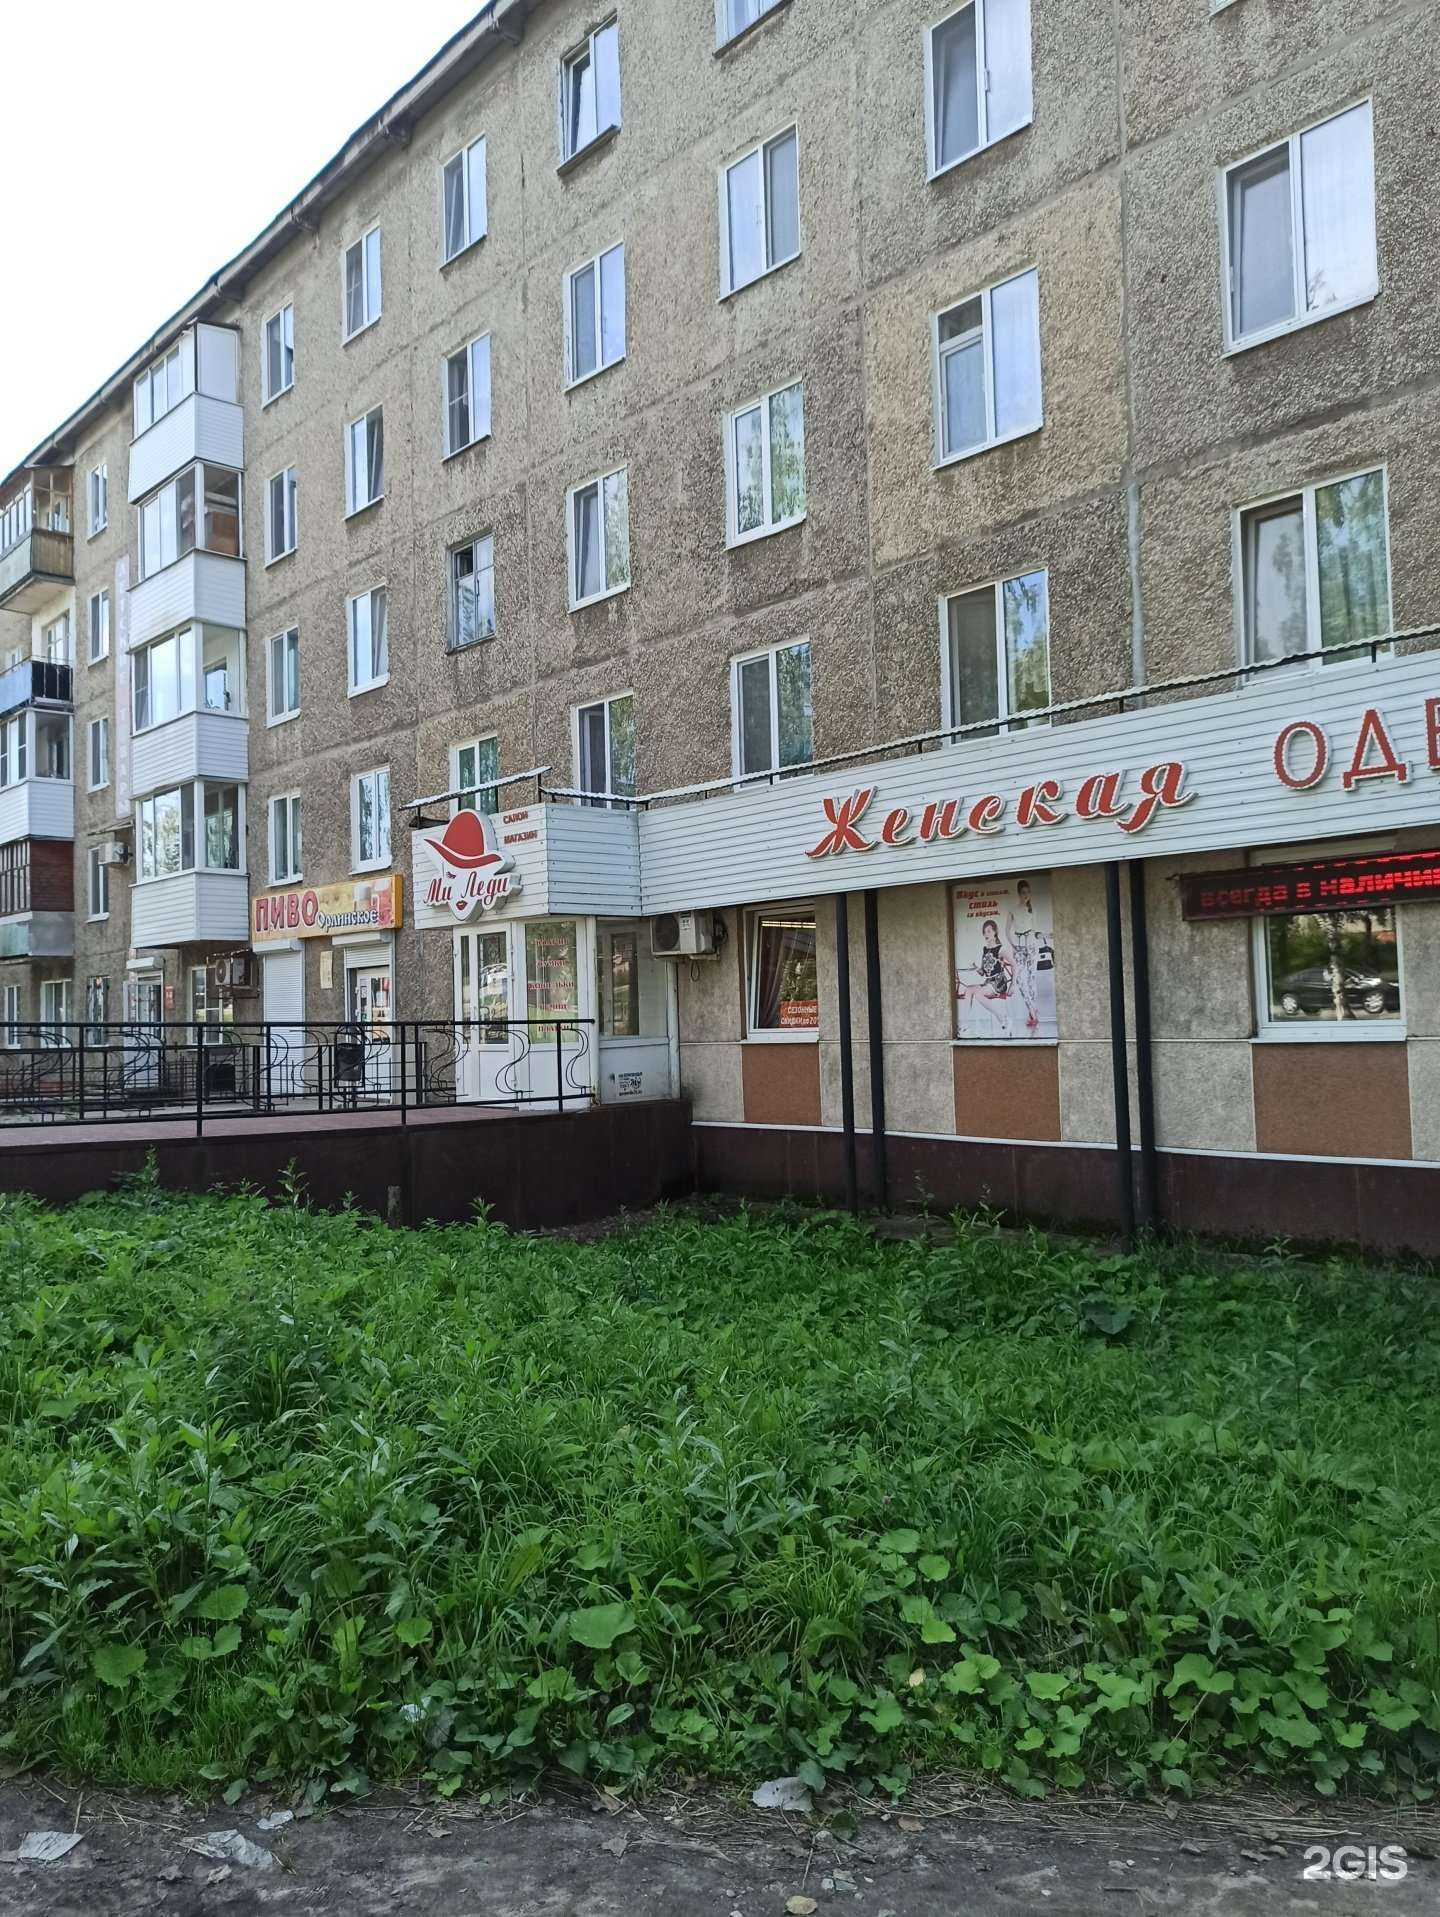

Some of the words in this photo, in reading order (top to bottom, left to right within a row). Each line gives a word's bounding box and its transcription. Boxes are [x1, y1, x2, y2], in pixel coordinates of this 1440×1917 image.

[503, 811, 528, 825] САЛОН
[805, 761, 1192, 859] Женская
[504, 830, 538, 844] МАГАЗИН
[424, 878, 452, 904] Ми
[461, 871, 508, 905] Леди
[1200, 885, 1288, 907] всегда
[1295, 882, 1311, 898] в
[255, 890, 319, 932] ПИВО
[317, 909, 379, 933] Орлинское
